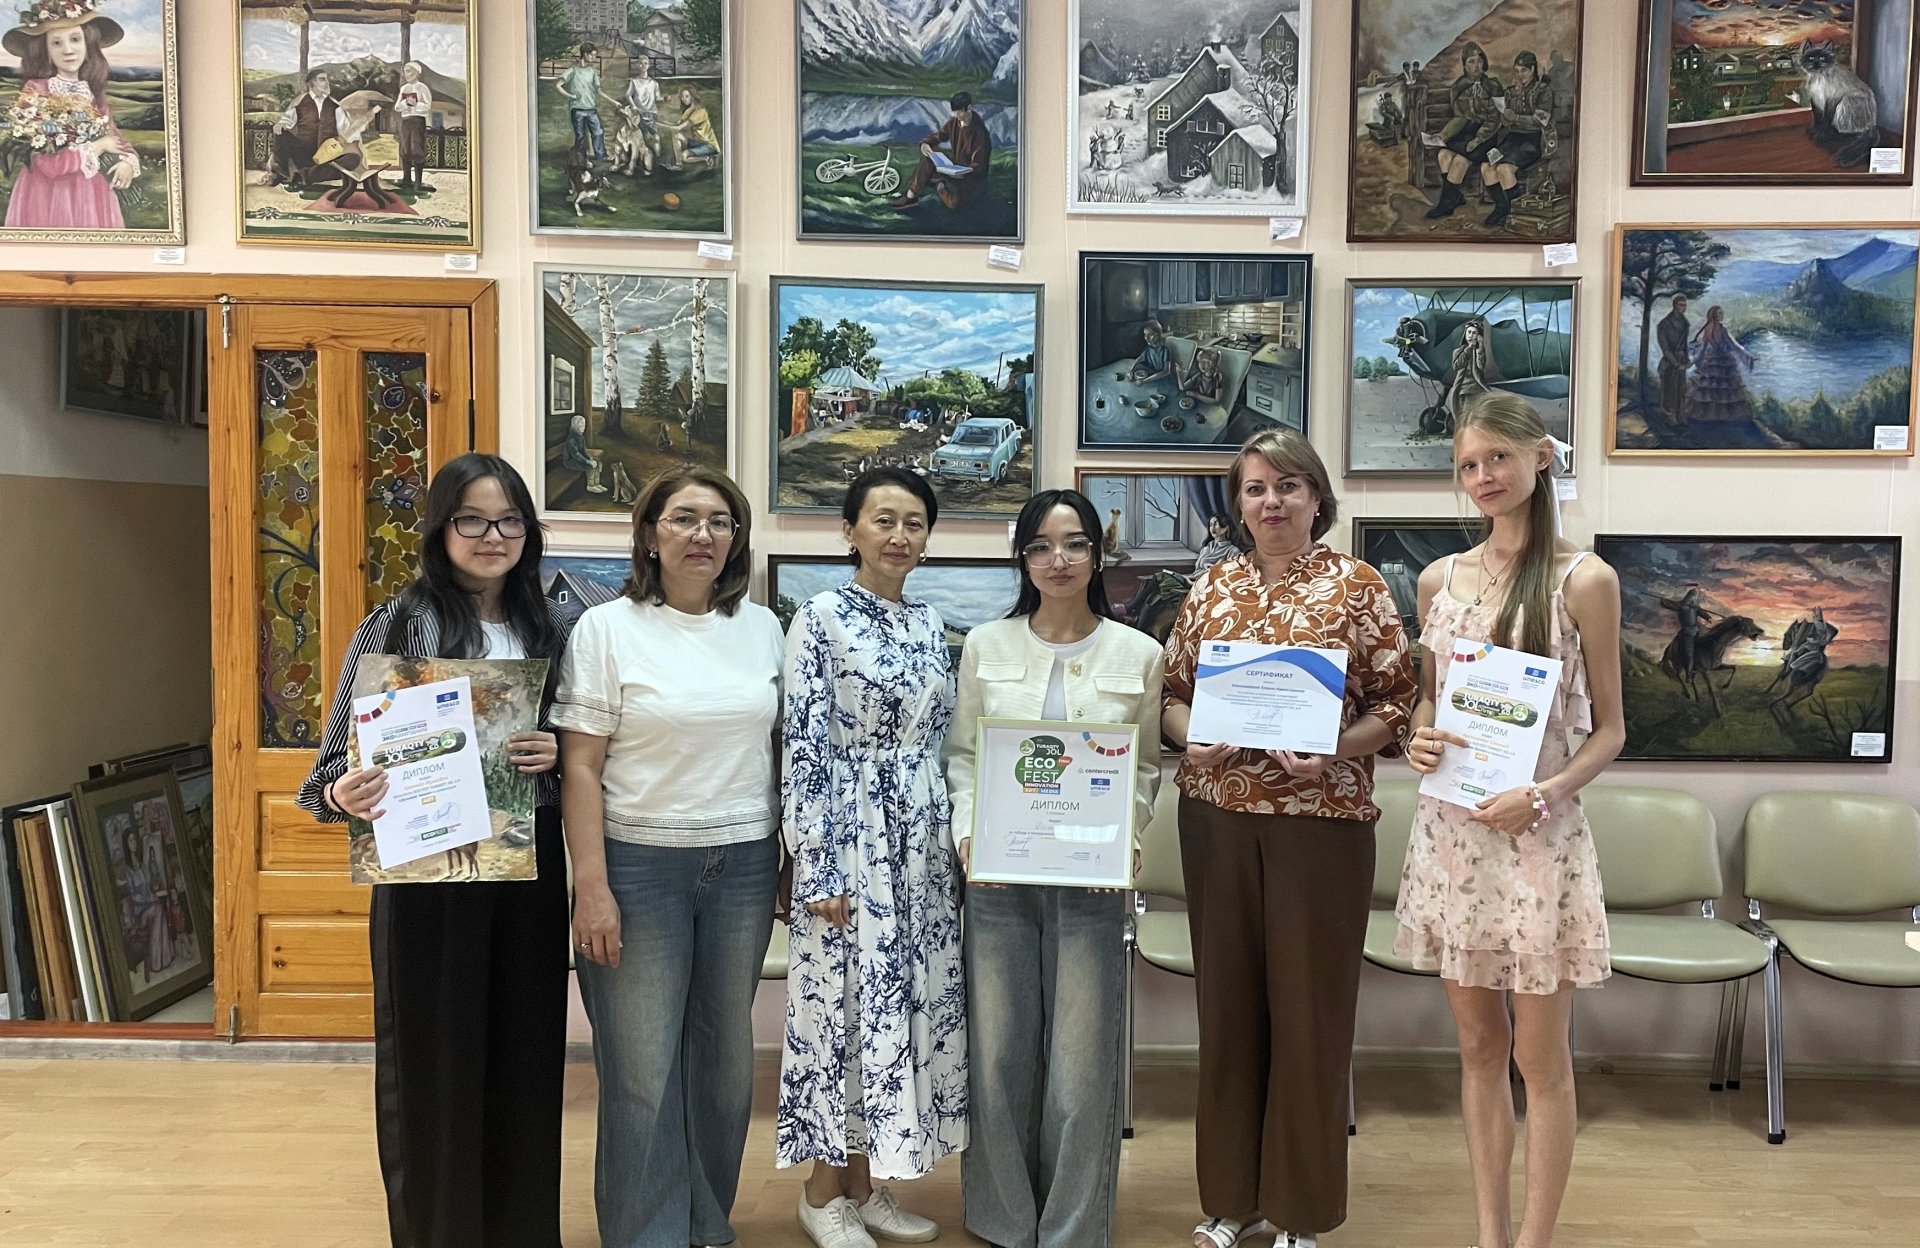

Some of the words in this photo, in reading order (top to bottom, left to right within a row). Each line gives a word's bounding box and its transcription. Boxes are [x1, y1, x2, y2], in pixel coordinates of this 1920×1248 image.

[1245, 670, 1294, 679] СЕРТИФИКАТ
[1523, 676, 1545, 684] unesco
[436, 700, 460, 710] unesco
[1460, 699, 1480, 711] JOL
[1464, 692, 1500, 706] TURAQTY
[1468, 720, 1508, 737] ДИПЛОМ
[384, 740, 424, 754] TURAQTY
[384, 752, 408, 764] JOL
[1024, 758, 1056, 768] ECO
[402, 762, 445, 782] ДИПЛОМ
[1024, 771, 1058, 783] FEST
[1030, 800, 1080, 811] ДИПЛОМ
